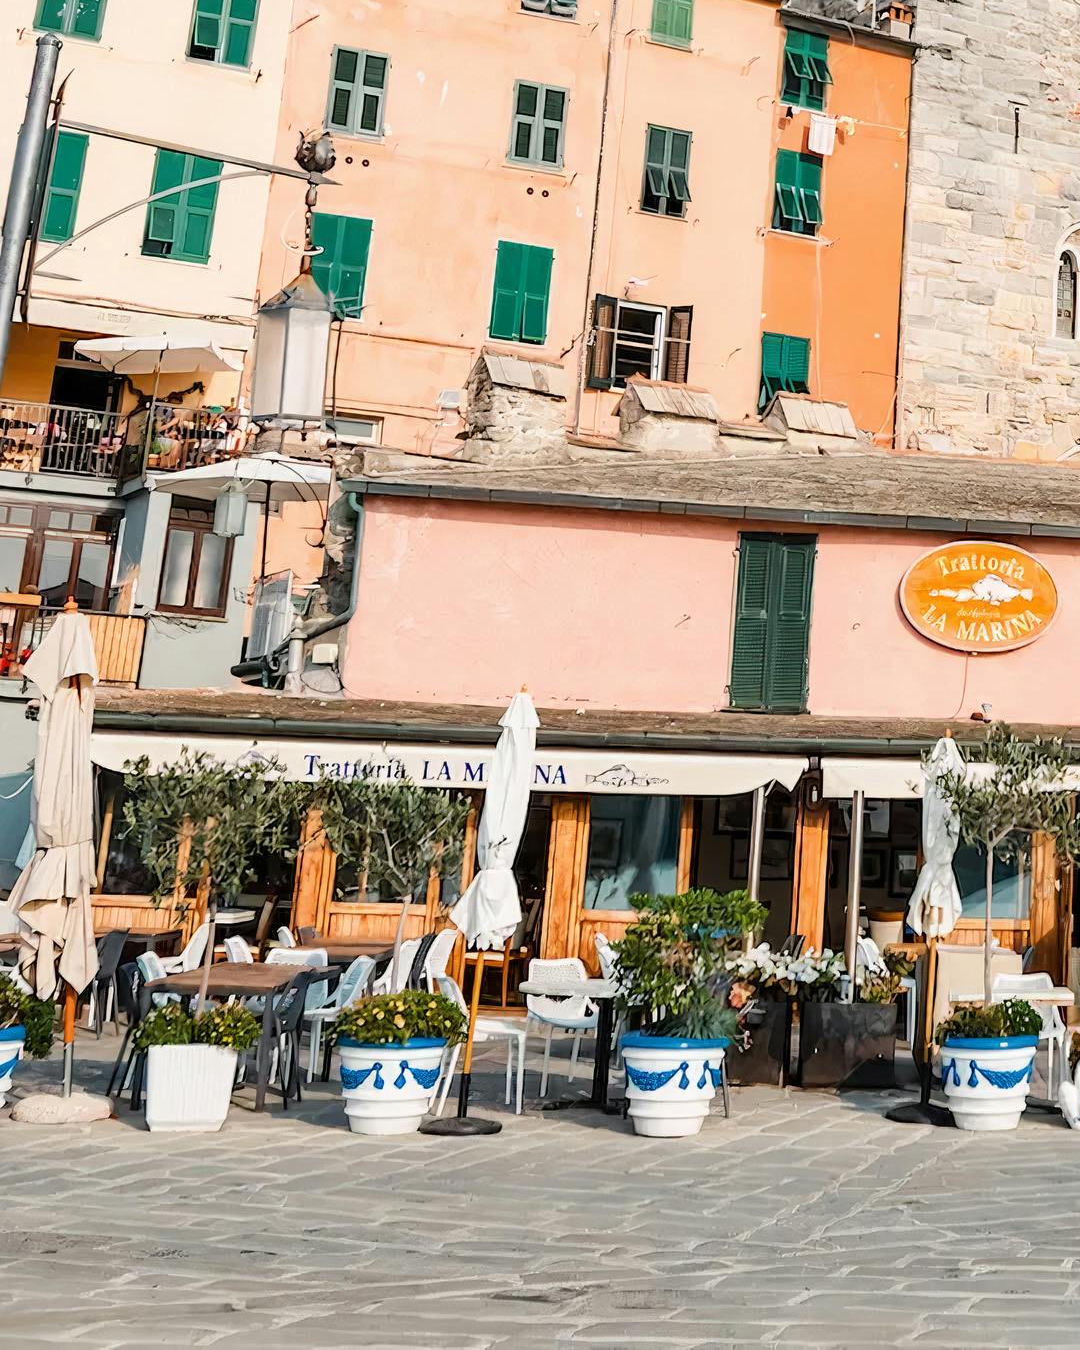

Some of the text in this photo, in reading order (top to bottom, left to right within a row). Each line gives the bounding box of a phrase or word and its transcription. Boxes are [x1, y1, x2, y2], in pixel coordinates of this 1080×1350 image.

[935, 554, 1025, 581] Trattoria
[921, 604, 946, 633] LA
[956, 610, 1042, 642] MARINA
[422, 760, 451, 781] LA
[463, 762, 566, 785] MNA
